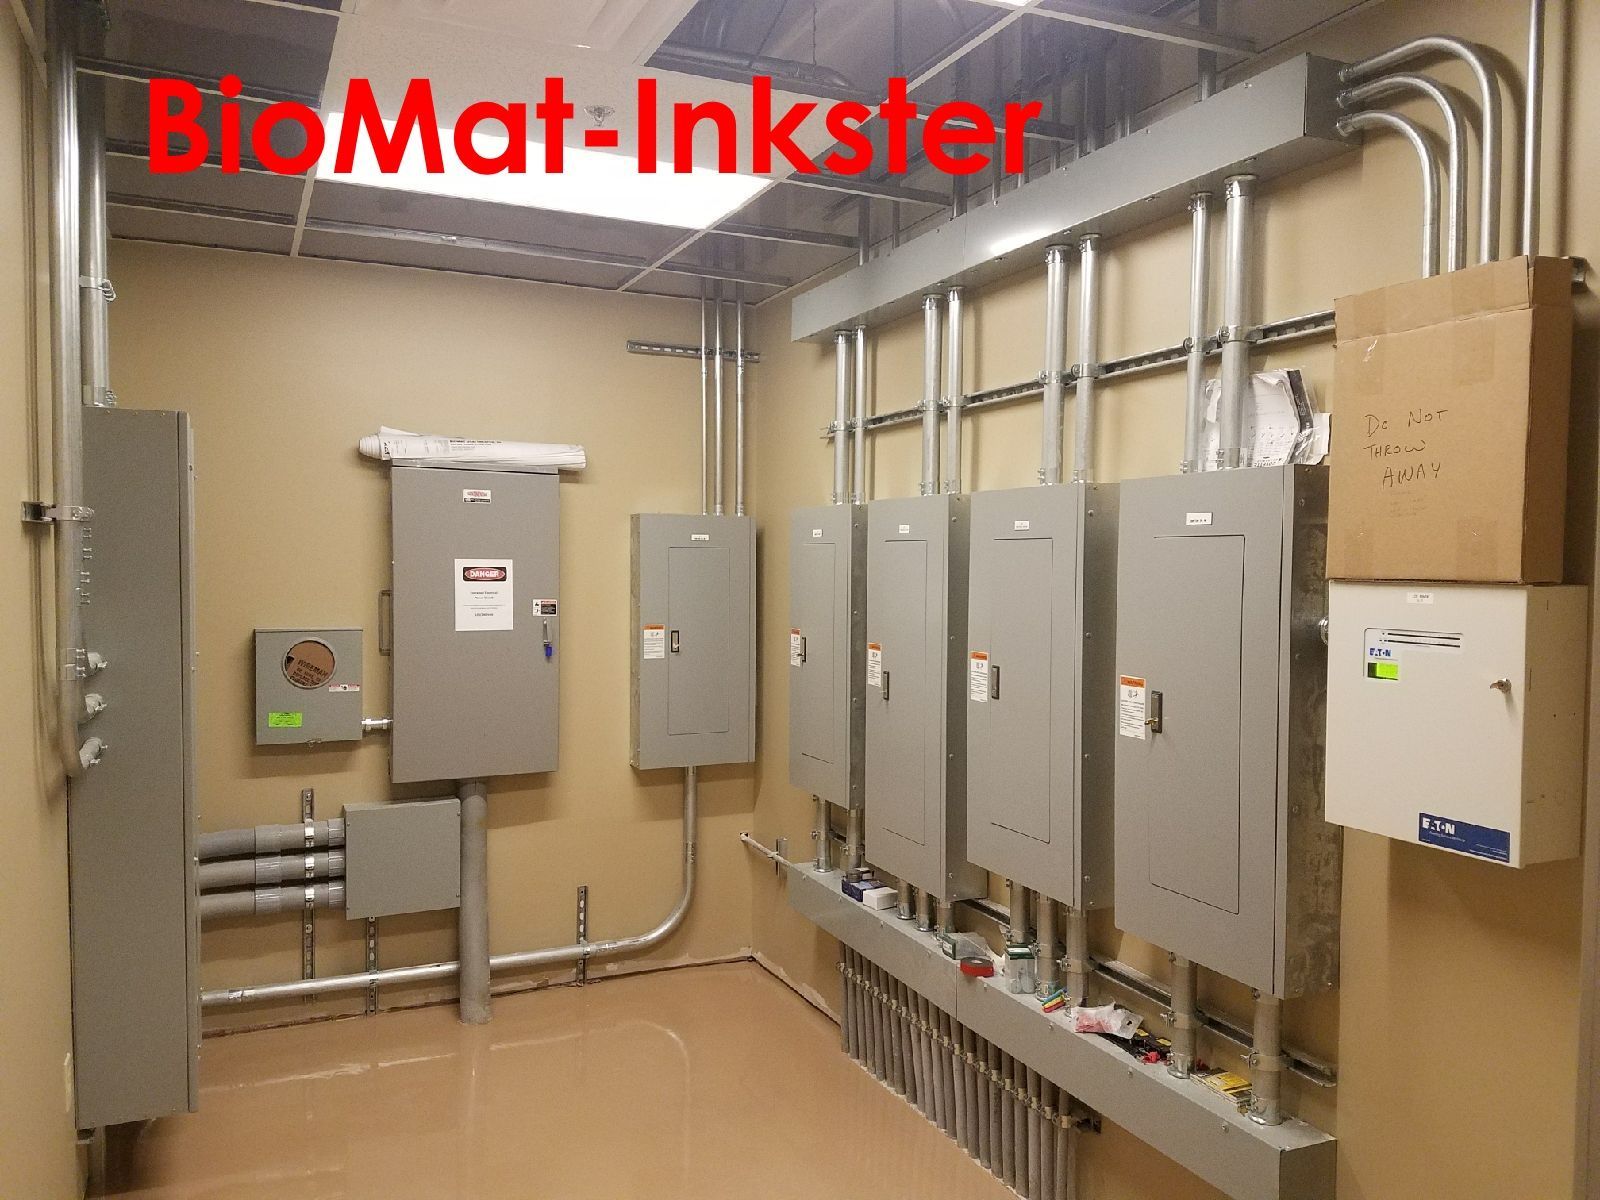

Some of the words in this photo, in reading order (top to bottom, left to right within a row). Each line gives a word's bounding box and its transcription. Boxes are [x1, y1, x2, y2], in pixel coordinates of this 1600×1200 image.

[1407, 408, 1448, 428] NOT
[1363, 439, 1426, 460] THROW
[1382, 462, 1441, 490] AWAY
[469, 570, 500, 578] DANGER
[1369, 647, 1392, 657] EATON
[1422, 817, 1456, 835] EATON
